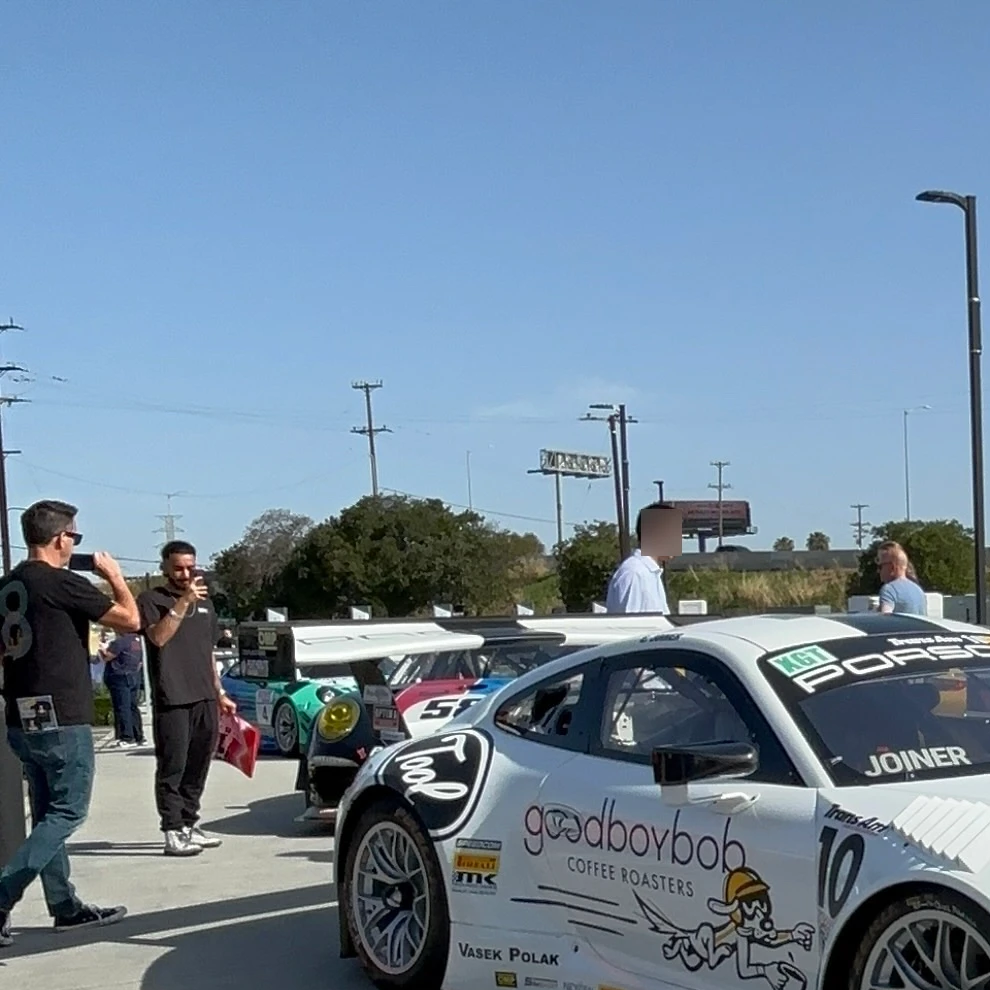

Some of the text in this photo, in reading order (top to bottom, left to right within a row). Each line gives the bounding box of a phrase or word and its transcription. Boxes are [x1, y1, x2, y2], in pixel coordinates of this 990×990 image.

[775, 648, 829, 674] XGT
[395, 734, 469, 805] Tool
[864, 746, 972, 777] JOINER
[524, 797, 746, 873] goodboybob
[568, 856, 694, 897] COFFEE ROASTERS
[819, 826, 865, 919] 10
[458, 942, 560, 966] VASEK POLAK
